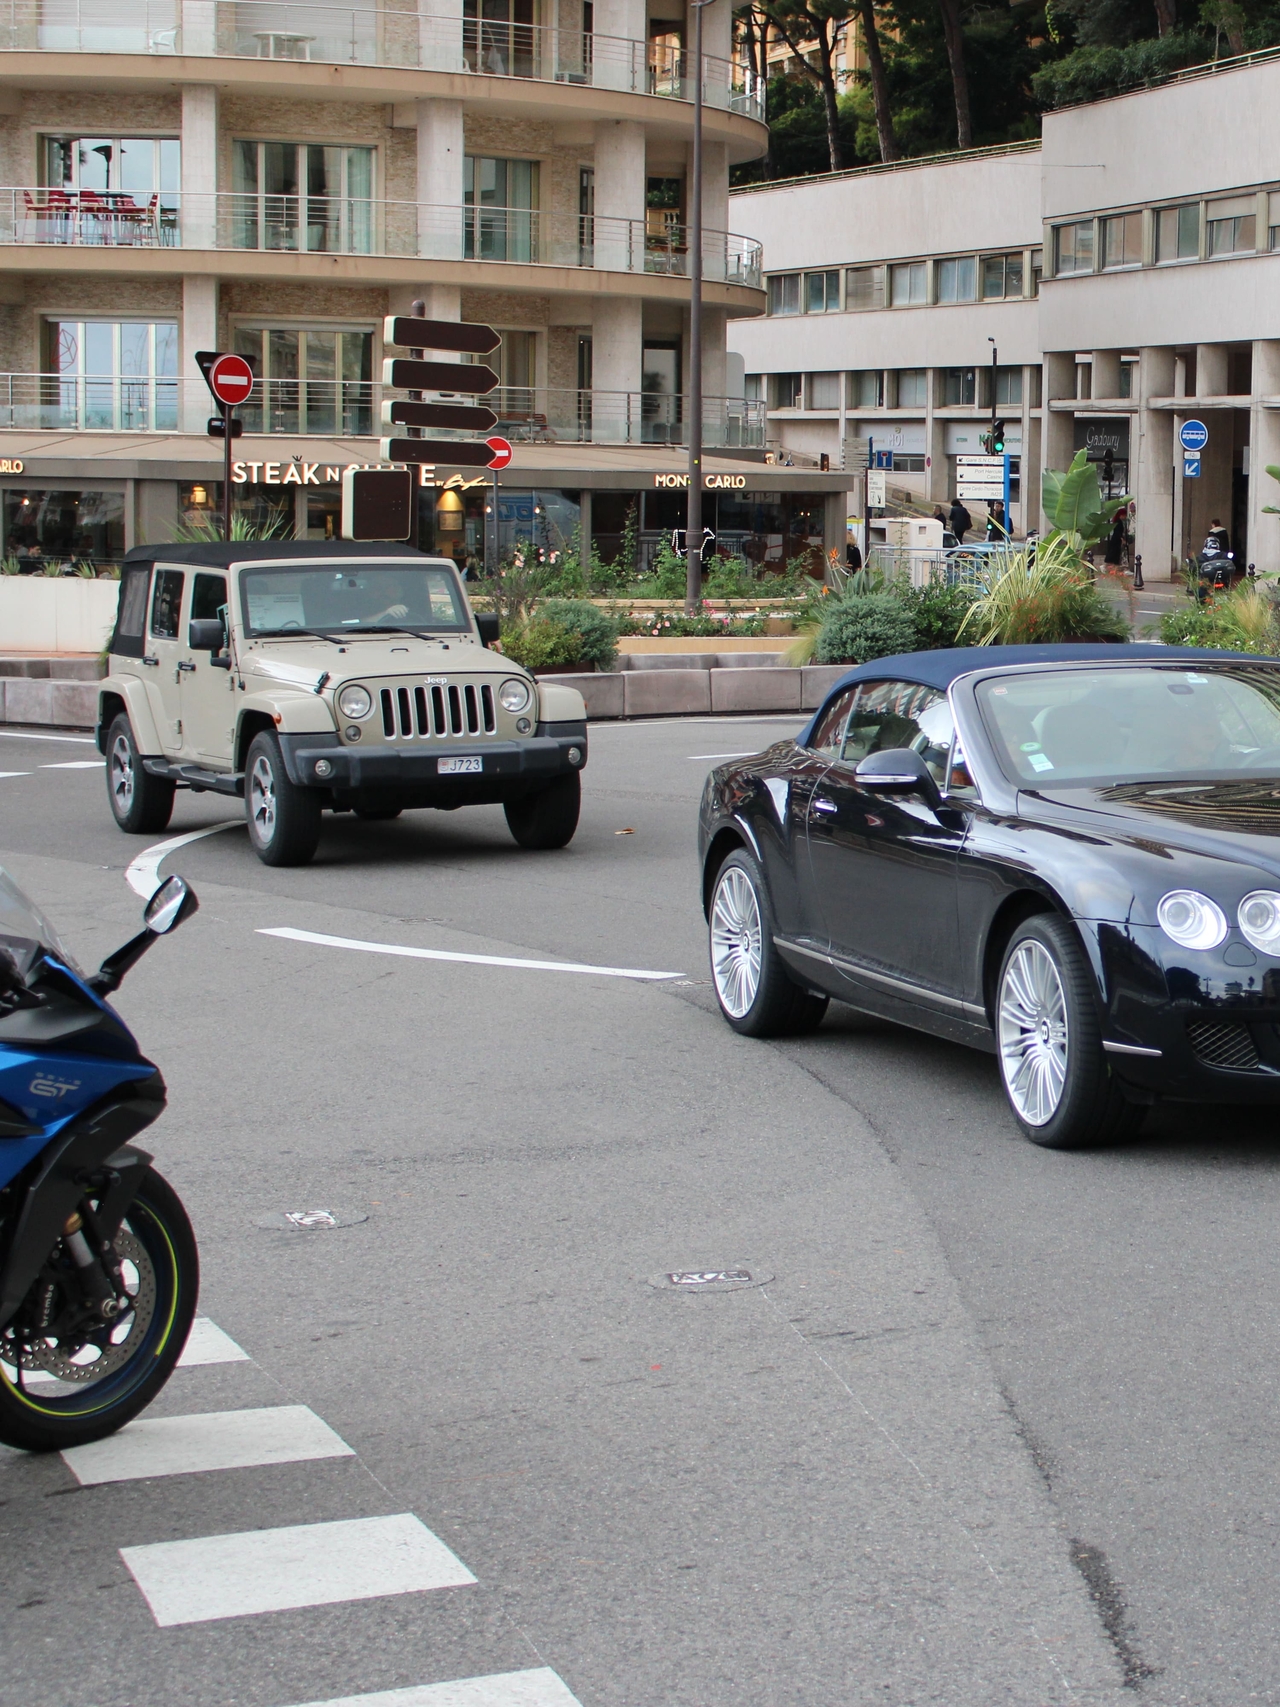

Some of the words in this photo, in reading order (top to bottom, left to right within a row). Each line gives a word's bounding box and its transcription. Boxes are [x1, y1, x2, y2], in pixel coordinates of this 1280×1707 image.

[1086, 426, 1121, 452] Gadoury
[231, 462, 321, 485] STEAK
[326, 466, 340, 483] N
[654, 474, 690, 488] MON
[705, 475, 745, 489] CARLO
[424, 676, 447, 685] Jeep
[449, 759, 480, 771] J723
[29, 1079, 79, 1098] GT
[40, 1284, 54, 1327] brembo
